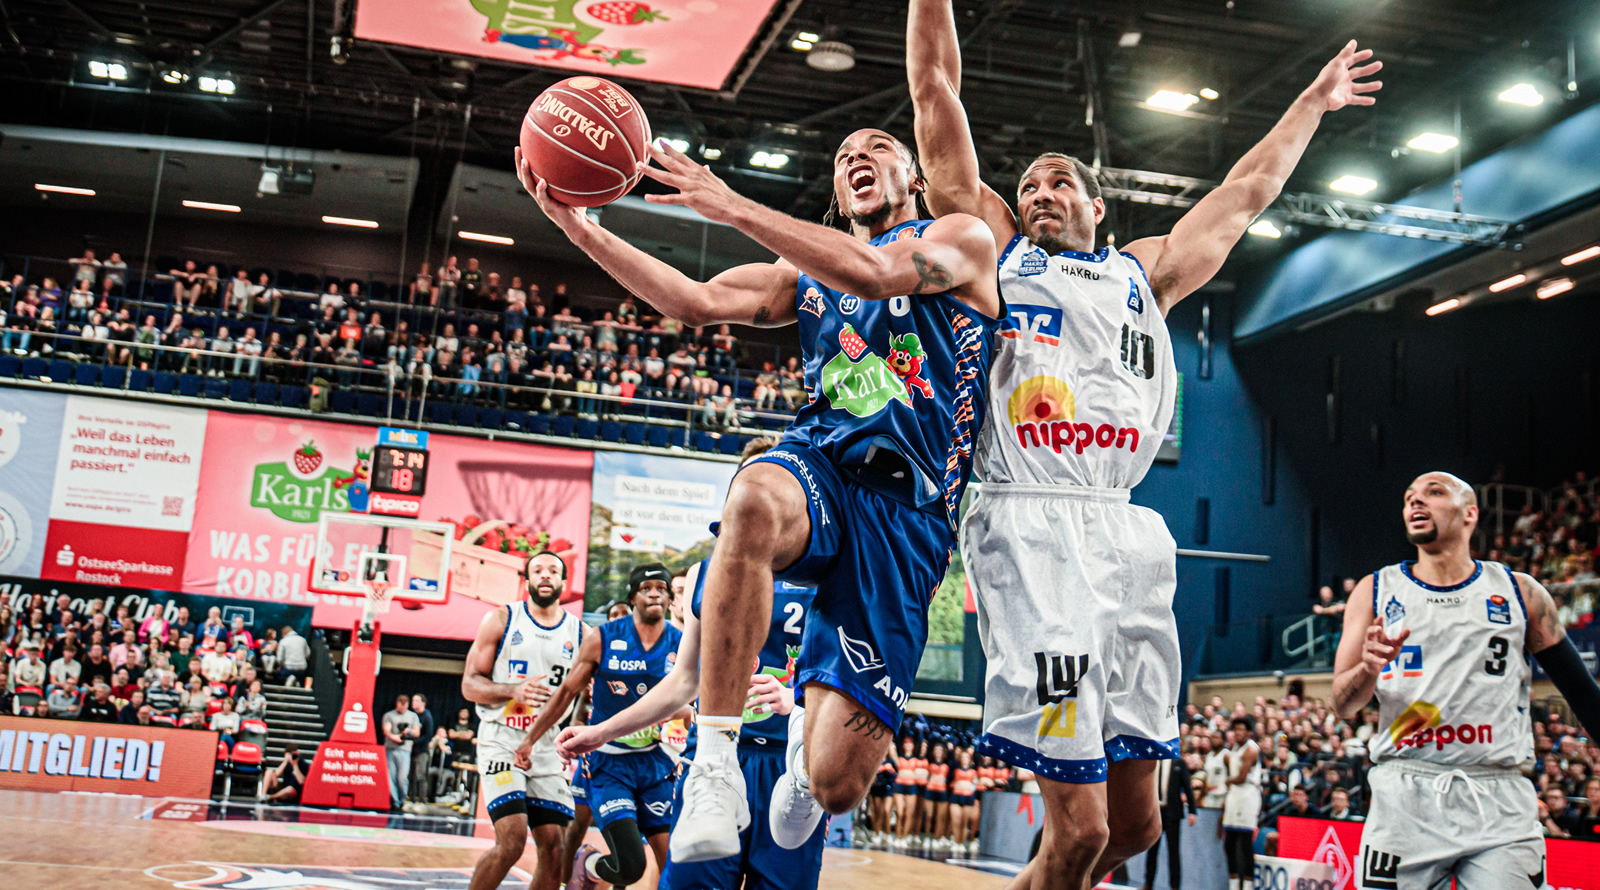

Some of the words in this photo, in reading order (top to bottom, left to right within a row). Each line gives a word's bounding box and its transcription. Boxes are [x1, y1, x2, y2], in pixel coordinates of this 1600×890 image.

[536, 92, 615, 151] SPALDING
[1061, 264, 1100, 281] HAKRO
[1120, 322, 1154, 380] 10
[830, 360, 906, 402] Karls
[109, 430, 132, 443] das
[136, 433, 175, 447] Leben
[1016, 420, 1140, 455] nippon
[73, 444, 140, 459] manchmal
[144, 449, 191, 464] einfach
[391, 468, 414, 492] 18
[622, 481, 650, 493] Nach
[654, 485, 679, 496] dem
[683, 488, 710, 500] Spiel
[256, 472, 349, 511] Karls
[373, 494, 419, 512] tipico
[637, 511, 654, 519] vor
[658, 512, 683, 521] dem
[210, 529, 271, 562] WAS
[280, 533, 334, 568] FÜR
[78, 555, 174, 576] OstseeSparkasse
[75, 570, 121, 584] Rostock
[216, 566, 365, 606] KORBL
[1427, 596, 1461, 604] HAKRO
[620, 660, 647, 671] OSPA
[1484, 635, 1509, 677] 3
[549, 664, 571, 687] 3
[844, 711, 886, 741] 1993
[323, 760, 342, 770] Nah
[343, 760, 359, 771] bei
[359, 763, 378, 773] mir.
[321, 772, 349, 784] Meine
[350, 774, 376, 786] OSPA.
[1252, 863, 1289, 890] BDO
